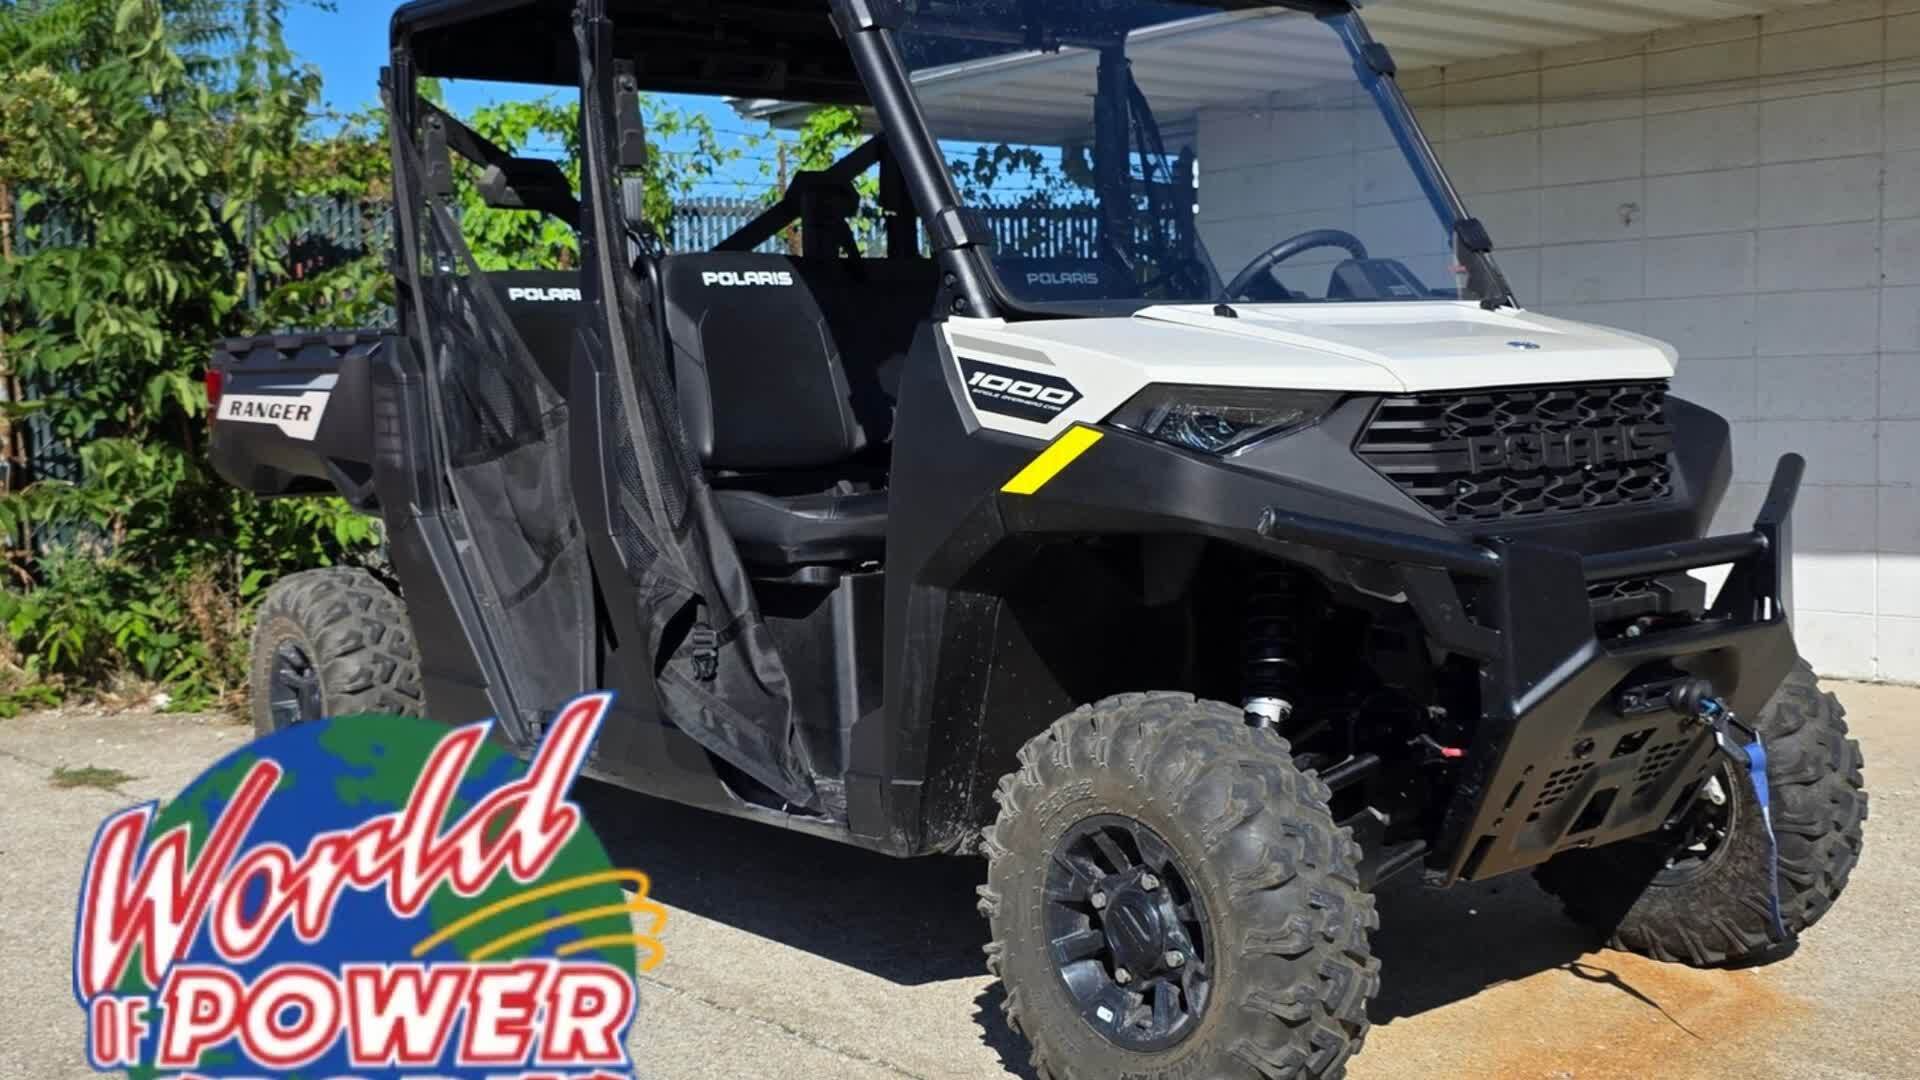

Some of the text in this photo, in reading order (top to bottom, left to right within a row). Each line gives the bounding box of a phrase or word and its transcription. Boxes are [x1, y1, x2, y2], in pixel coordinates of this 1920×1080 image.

[702, 271, 793, 286] POLARIS
[1026, 272, 1099, 285] POLARIS
[508, 287, 582, 301] POLARI
[968, 371, 1074, 405] 1000
[229, 400, 312, 421] RANGER
